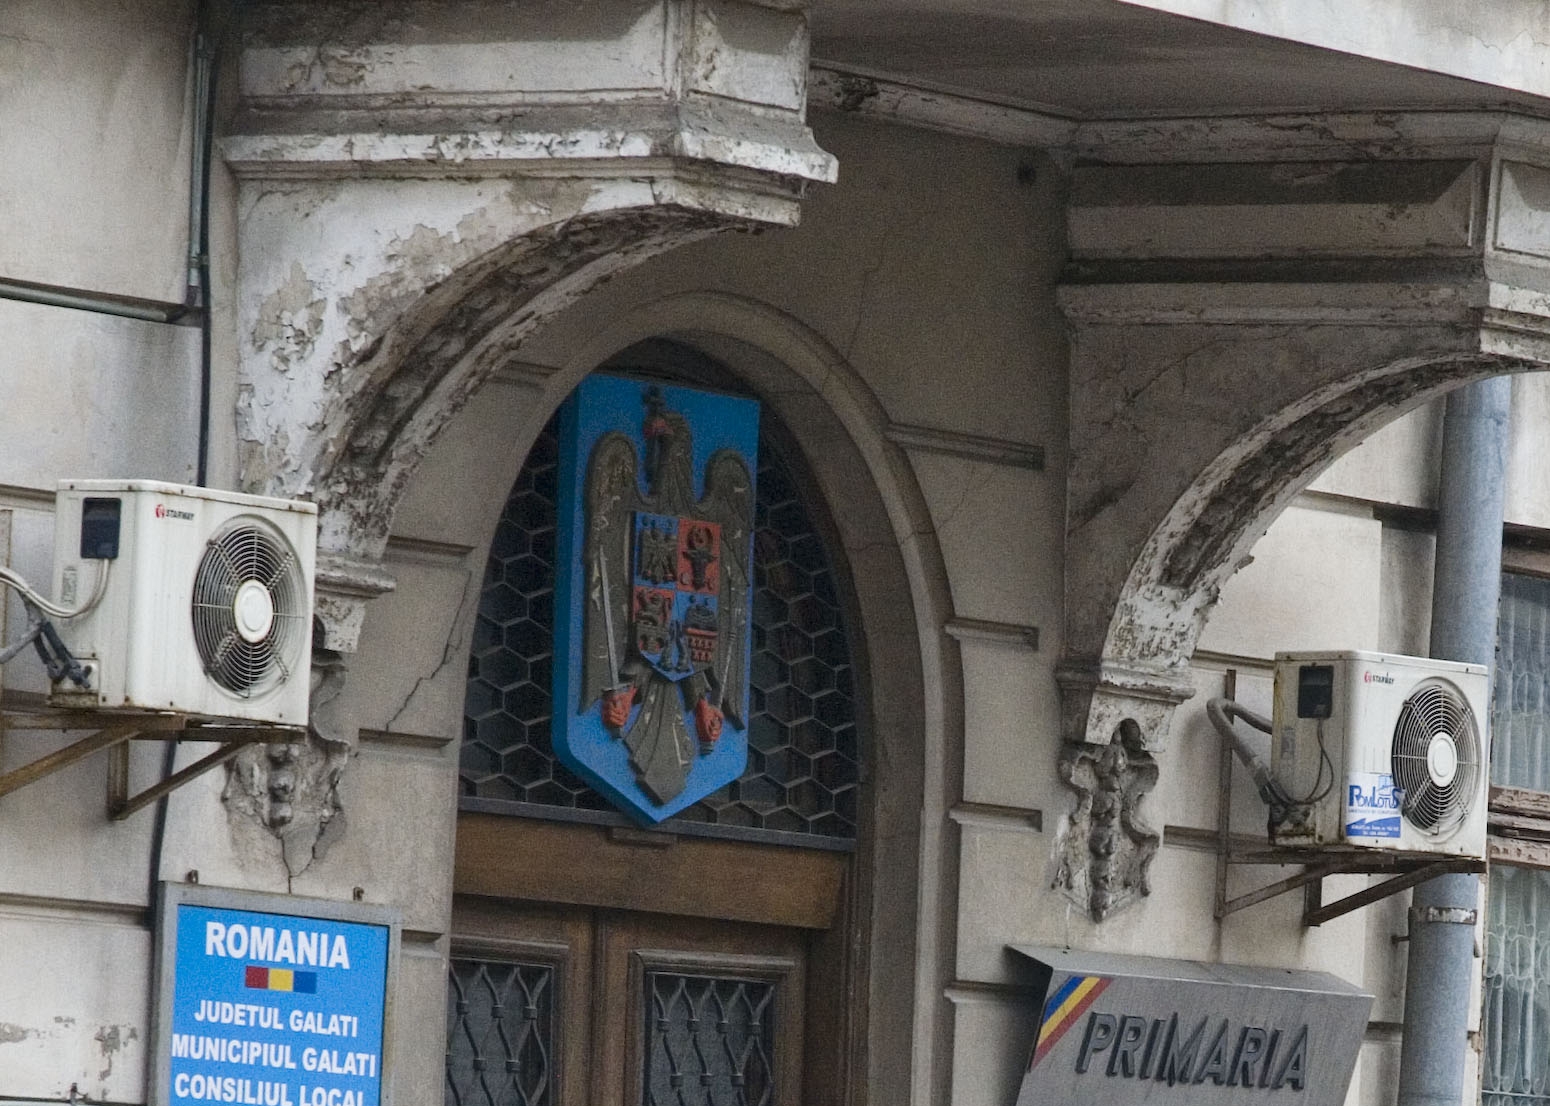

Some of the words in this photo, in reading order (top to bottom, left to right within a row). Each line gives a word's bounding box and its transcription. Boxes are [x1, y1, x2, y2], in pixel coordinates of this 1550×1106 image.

[205, 921, 350, 970] ROMANIA
[194, 1000, 284, 1030] JUDETUL
[289, 1010, 358, 1038] GALATI
[172, 1033, 297, 1070] MUNICIPIUL
[302, 1047, 376, 1078] GALATI
[1074, 1011, 1309, 1091] PRIMARIA
